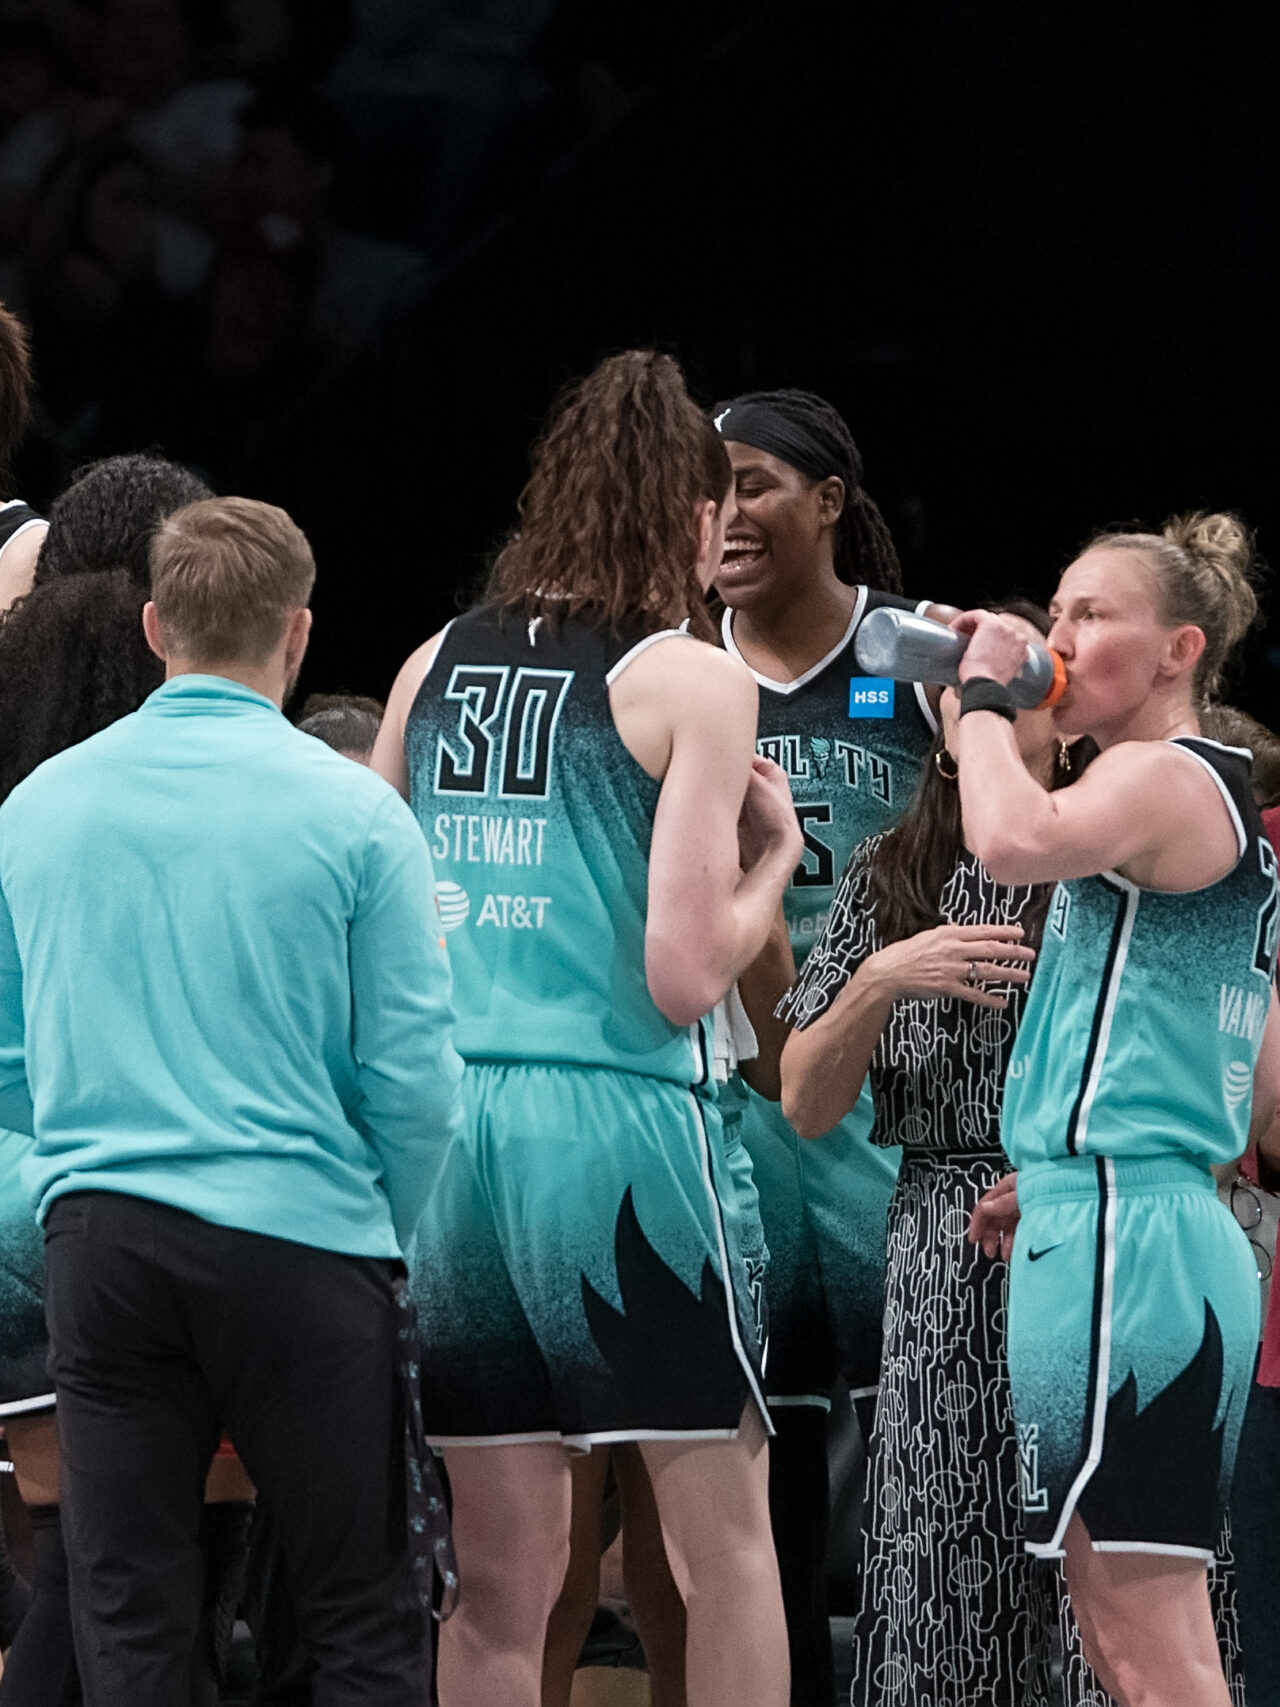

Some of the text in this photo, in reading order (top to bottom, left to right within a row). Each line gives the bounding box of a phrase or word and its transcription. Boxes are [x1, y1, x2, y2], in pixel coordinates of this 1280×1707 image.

[854, 690, 889, 704] HSS
[431, 664, 575, 800] 30
[432, 813, 548, 866] STEWART
[475, 893, 552, 930] AT&T
